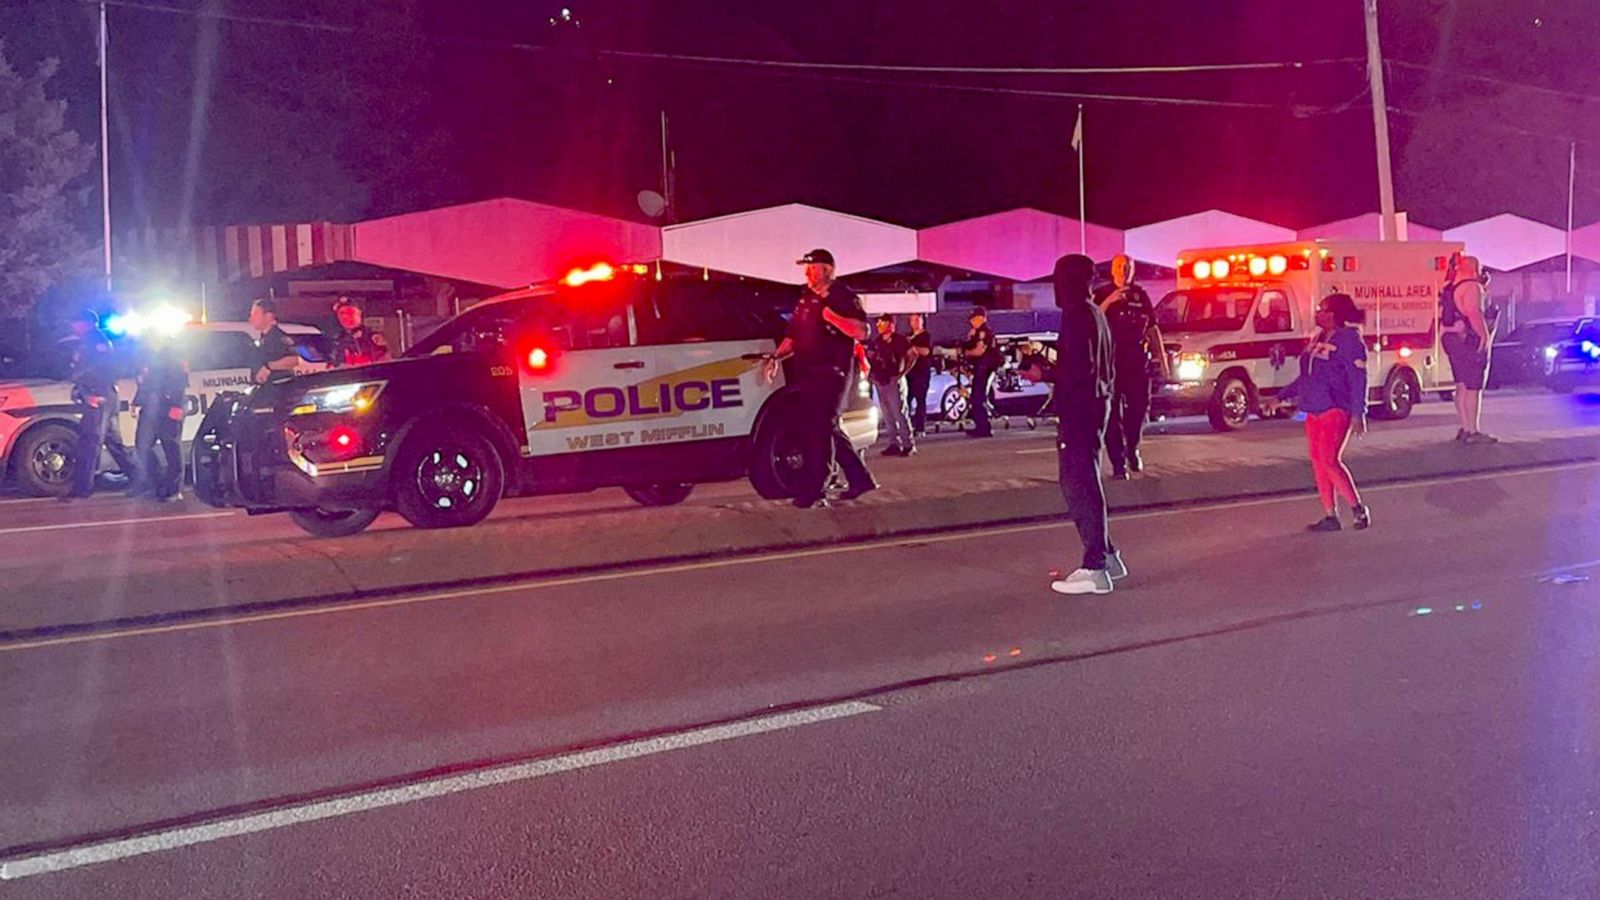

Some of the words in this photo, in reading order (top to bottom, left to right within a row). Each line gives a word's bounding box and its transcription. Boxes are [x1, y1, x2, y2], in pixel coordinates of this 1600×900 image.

[1354, 285, 1403, 298] MUNHALL
[1406, 285, 1432, 297] AREA
[202, 375, 250, 388] MUNHAL
[542, 378, 743, 422] POLICE
[566, 431, 634, 449] WEST
[640, 423, 724, 442] MIFFLIN
